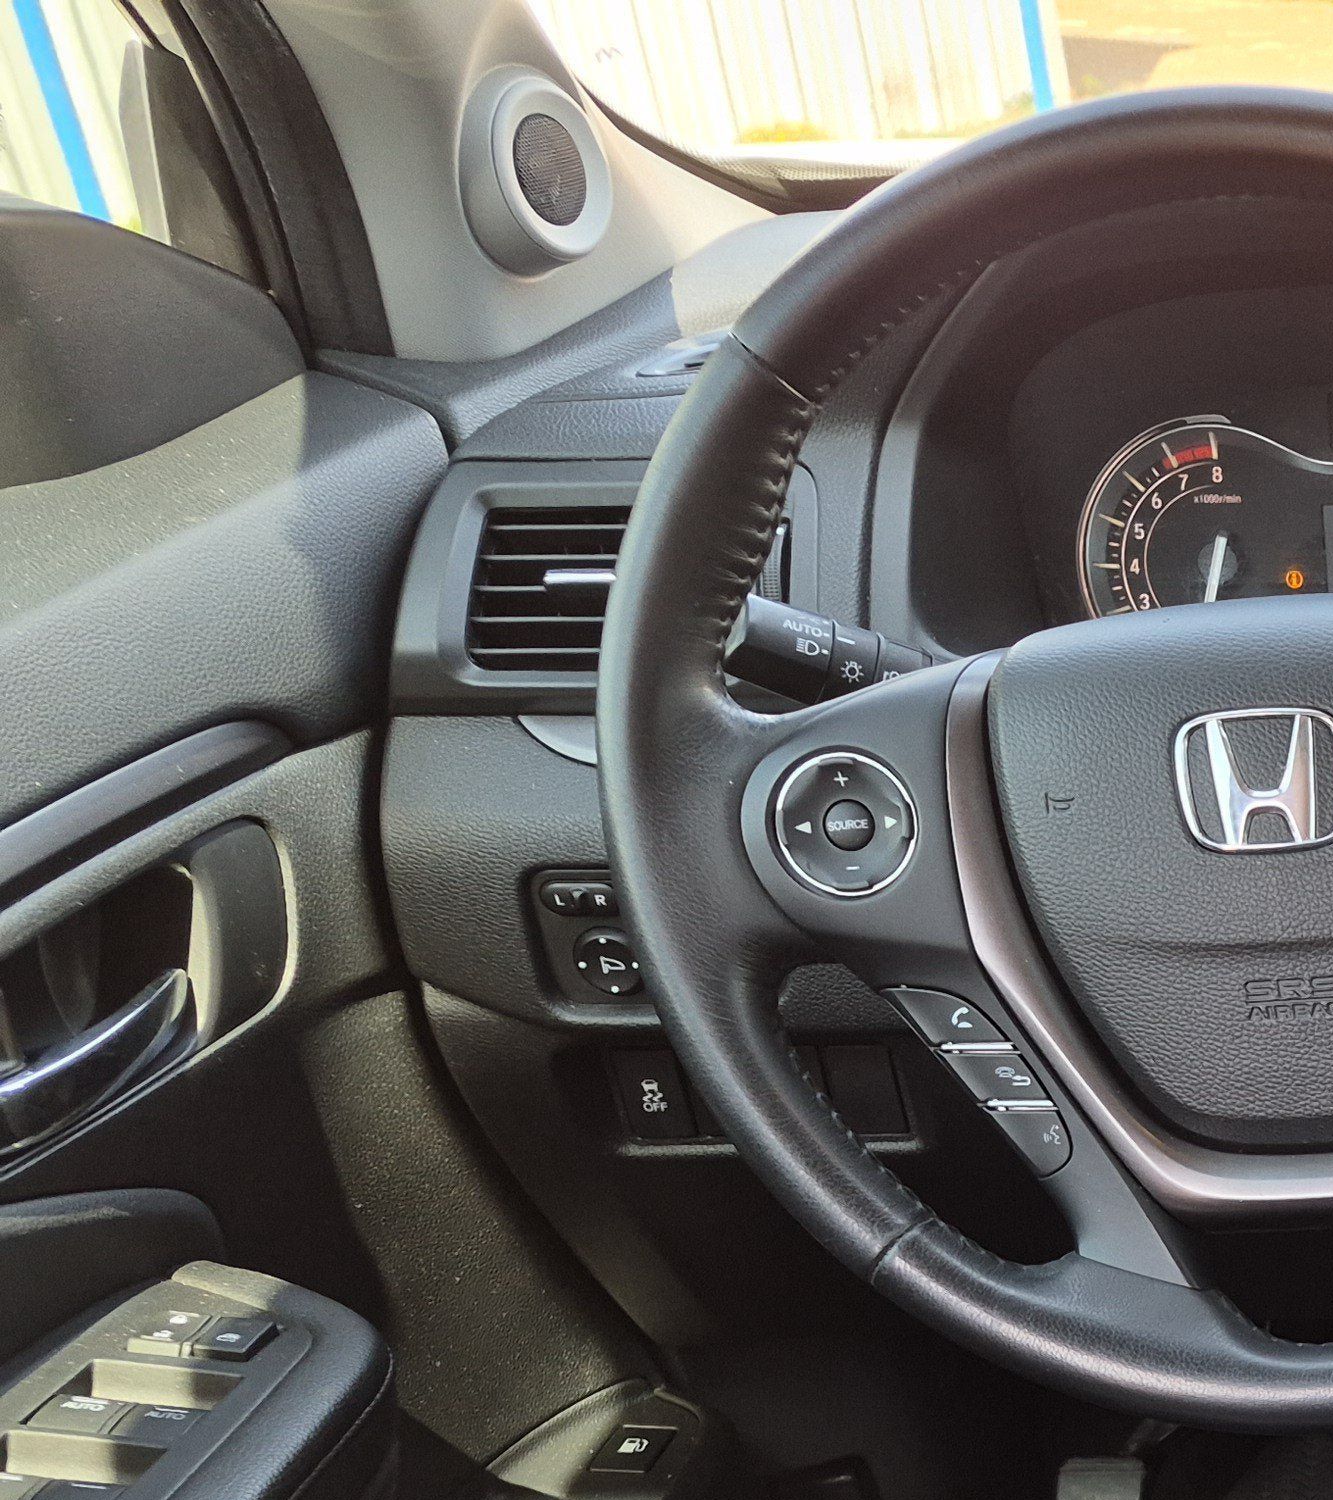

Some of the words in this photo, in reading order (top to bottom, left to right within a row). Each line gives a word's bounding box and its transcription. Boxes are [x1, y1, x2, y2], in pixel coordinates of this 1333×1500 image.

[1178, 474, 1189, 491] 7
[1212, 466, 1223, 483] 8
[1151, 492, 1162, 509] 6
[1134, 523, 1145, 540] 5
[1129, 558, 1140, 575] 4
[1139, 593, 1150, 610] 3
[783, 619, 822, 638] AUTO
[827, 818, 869, 831] SOURCE
[555, 893, 565, 906] L
[595, 895, 606, 906] R
[643, 1102, 668, 1112] OFF
[61, 1401, 106, 1412] AUTO
[145, 1411, 187, 1420] AUTO
